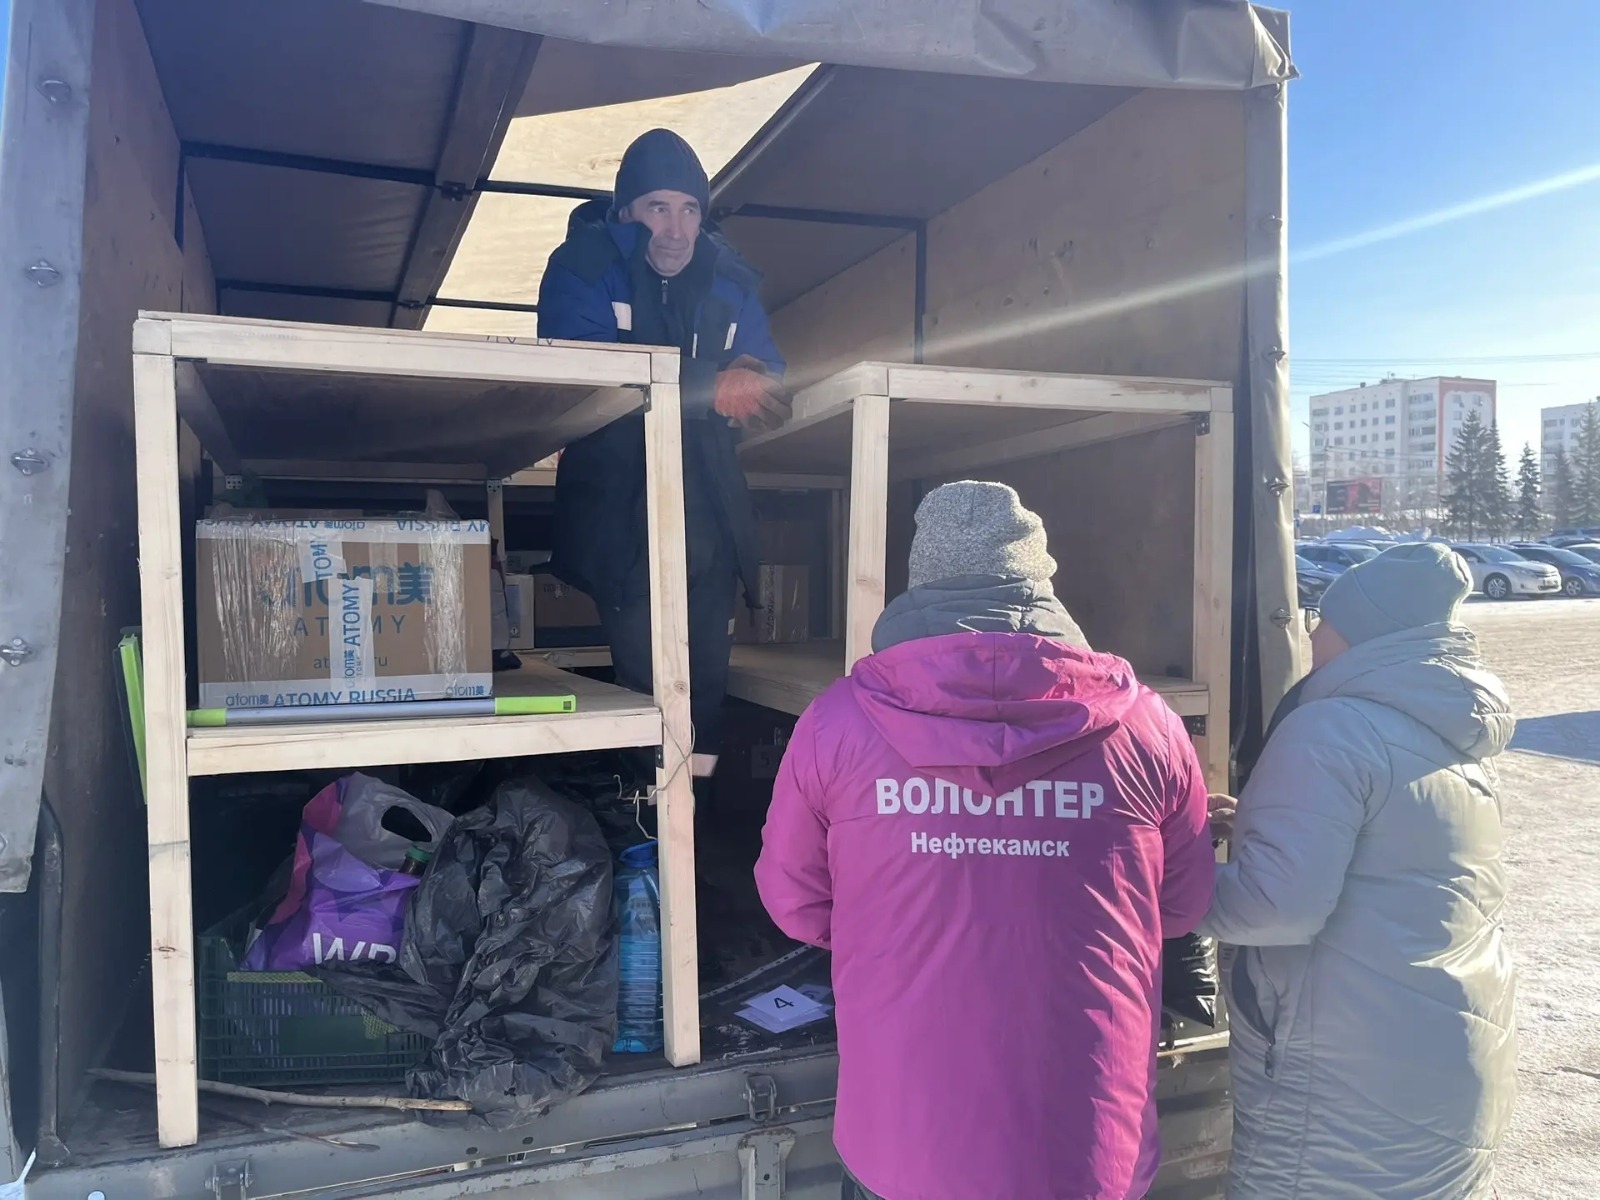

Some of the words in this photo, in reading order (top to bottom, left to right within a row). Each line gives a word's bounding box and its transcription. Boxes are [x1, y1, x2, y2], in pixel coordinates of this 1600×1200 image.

[293, 614, 406, 637] ATMY
[342, 584, 361, 647] ATOMY
[273, 691, 342, 706] ATOMY
[349, 688, 415, 703] RUSSIA
[875, 777, 1105, 820] ВОЛОНТЕР
[911, 831, 1070, 859] Нефтекамск
[773, 997, 795, 1009] 4
